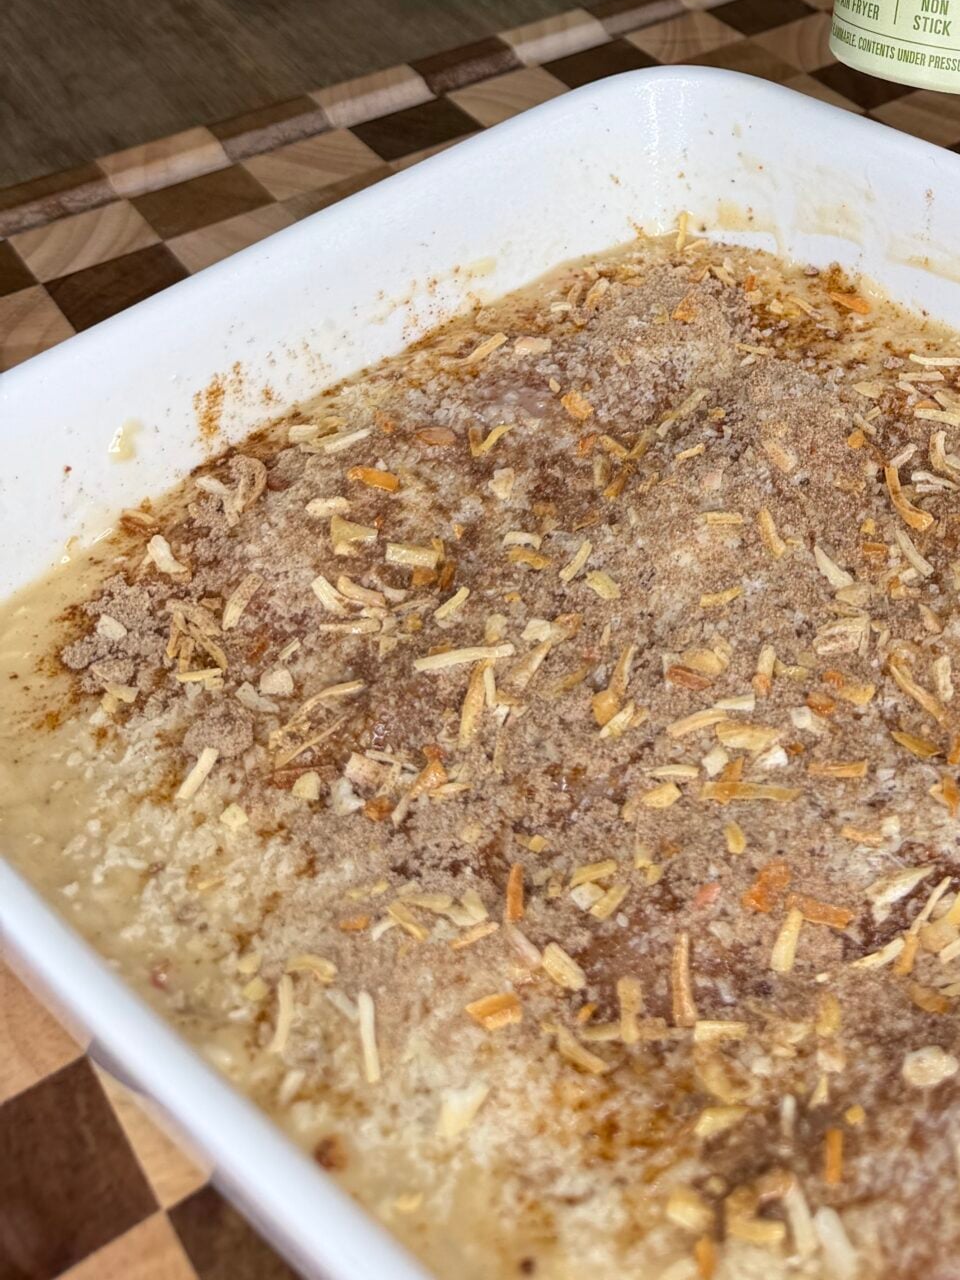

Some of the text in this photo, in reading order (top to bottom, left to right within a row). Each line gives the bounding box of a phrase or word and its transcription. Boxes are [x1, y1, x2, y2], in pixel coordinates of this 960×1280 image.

[913, 15, 952, 37] STICK
[858, 36, 895, 60] CONTENTS
[897, 47, 926, 66] UNDER
